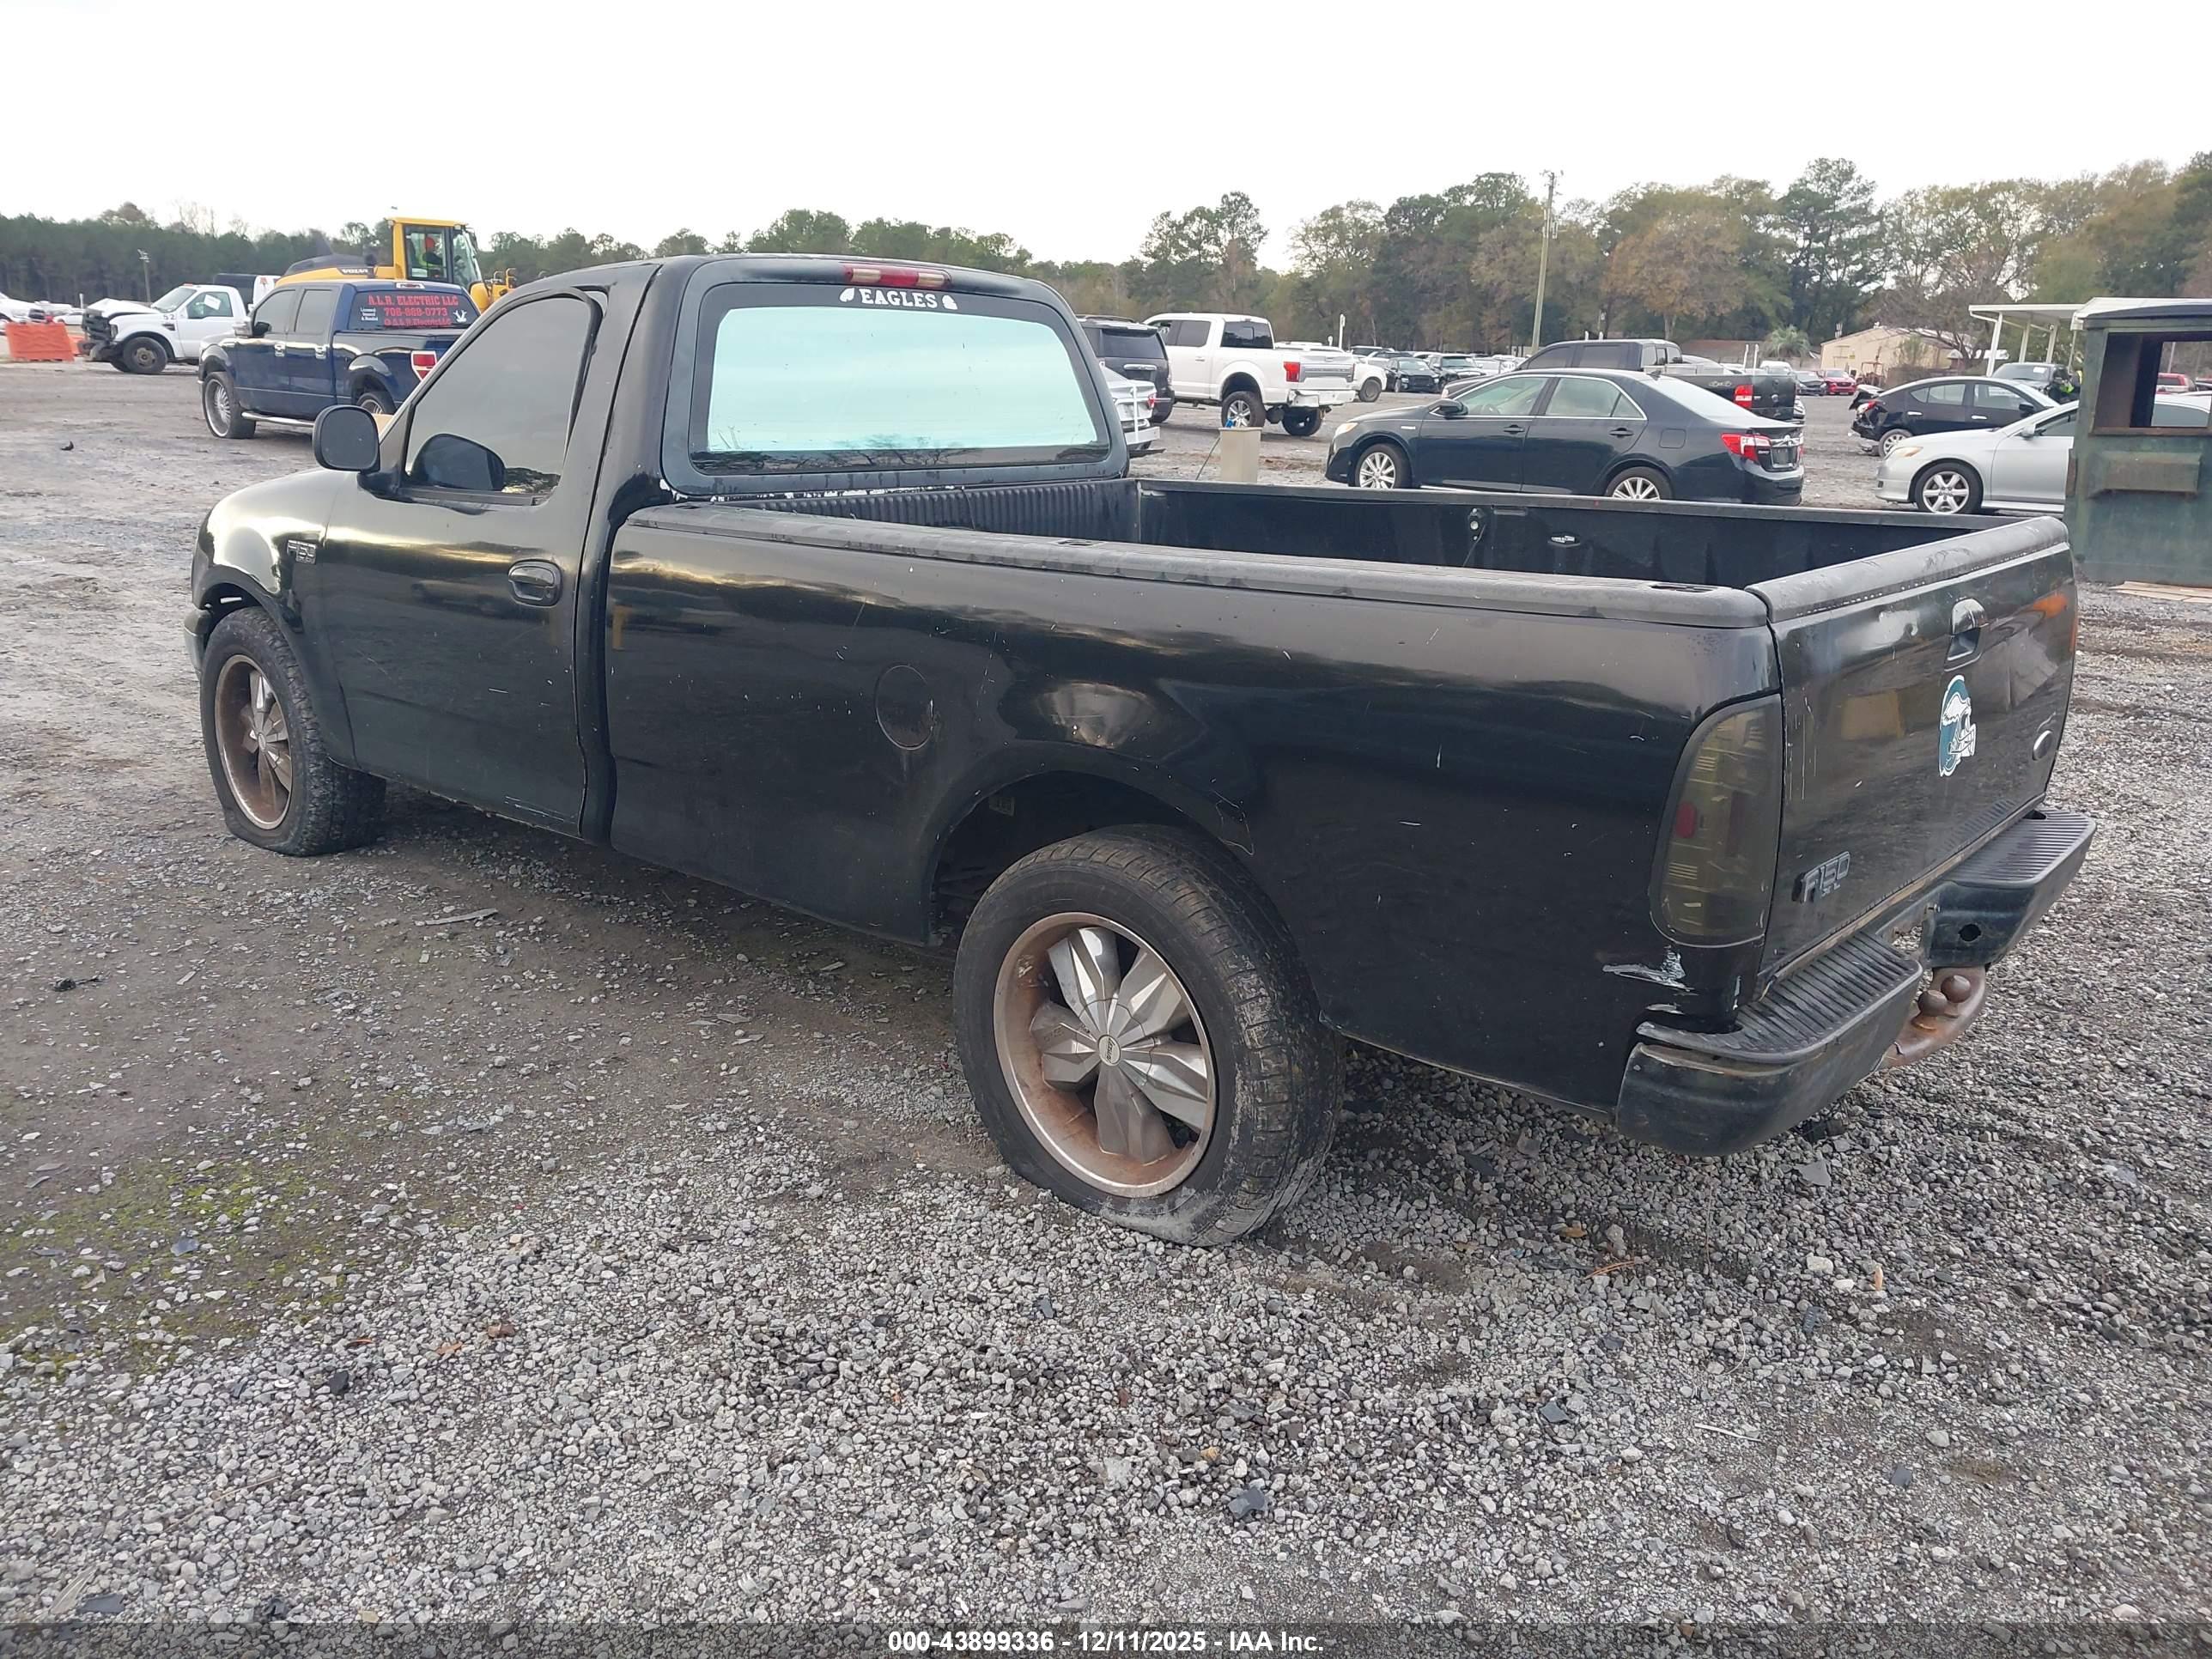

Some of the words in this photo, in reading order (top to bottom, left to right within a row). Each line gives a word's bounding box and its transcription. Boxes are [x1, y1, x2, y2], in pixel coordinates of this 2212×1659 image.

[397, 295, 440, 306] ELECTRIC
[442, 295, 459, 306] LLC
[859, 289, 938, 308] EAGLES
